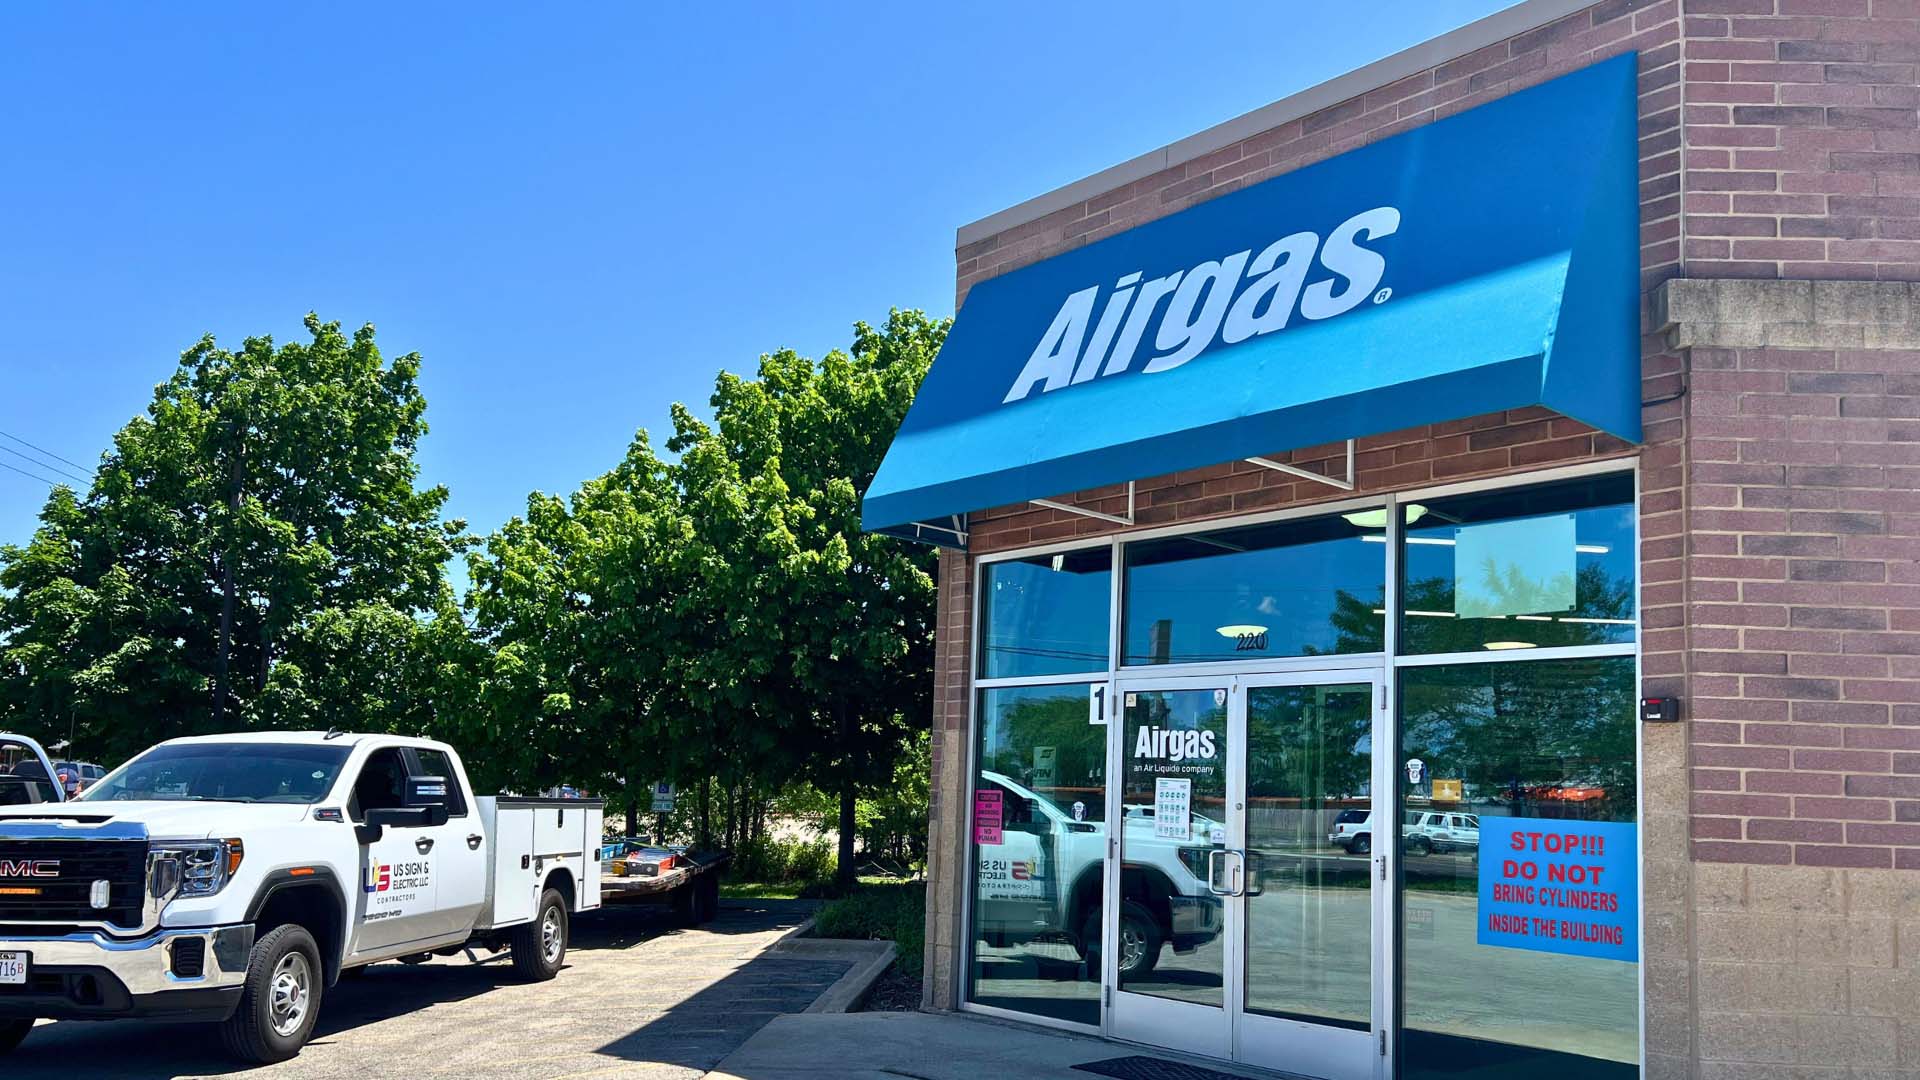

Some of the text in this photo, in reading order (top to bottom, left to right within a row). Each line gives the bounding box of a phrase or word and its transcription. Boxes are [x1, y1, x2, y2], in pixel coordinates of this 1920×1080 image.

[1002, 206, 1401, 404] Airgas
[1236, 632, 1266, 651] 220
[1094, 686, 1105, 721] 1
[1134, 725, 1216, 762] Airgas
[1143, 764, 1153, 772] Air
[1154, 765, 1180, 774] Liquide
[1181, 765, 1214, 775] company
[1511, 831, 1604, 855] STOP!!!
[394, 861, 429, 876] US SIGN &
[1503, 859, 1605, 885] DO NOT
[393, 876, 429, 890] ELECTRIC LLC
[377, 894, 415, 904] CONTRACTORS
[1493, 883, 1618, 912] BRING CYLINDERS
[1489, 913, 1623, 945] INSIDE THE BUILDING
